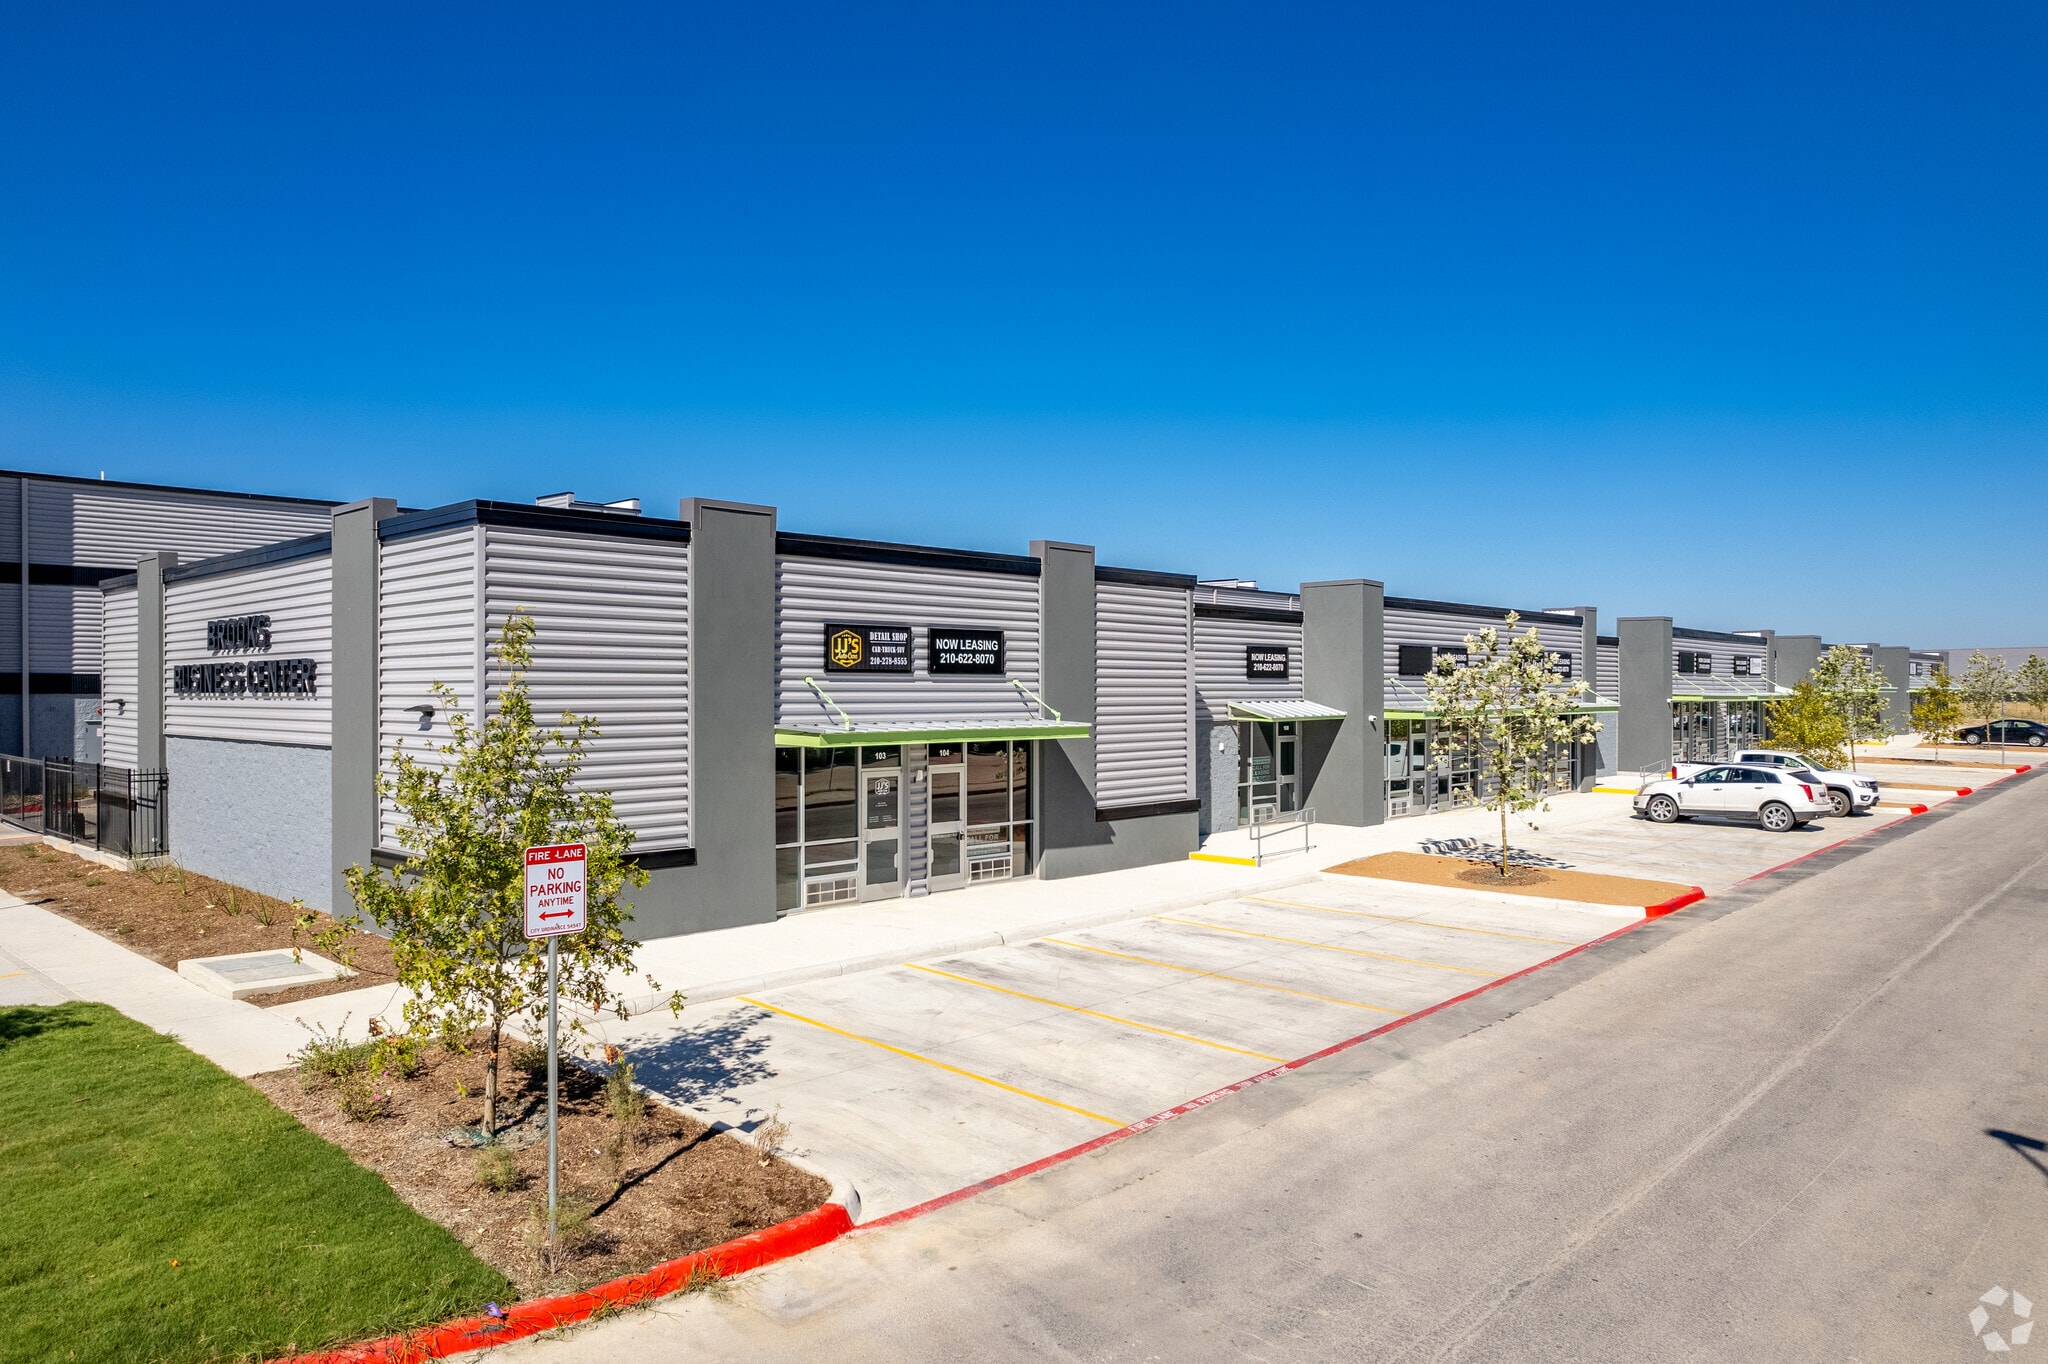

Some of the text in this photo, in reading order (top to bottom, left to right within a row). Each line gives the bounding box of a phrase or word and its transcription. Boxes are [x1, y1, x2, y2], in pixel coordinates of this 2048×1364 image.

[207, 615, 272, 651] BROOKS
[869, 631, 908, 641] DETAIL SHOP
[834, 637, 859, 654] JJ'S
[936, 638, 999, 651] NOW LEASING
[939, 652, 995, 665] 210-622-8070
[1251, 653, 1286, 661] NOW LEASING
[174, 658, 317, 693] BUSINESS CENTER
[875, 752, 887, 760] 103
[939, 749, 950, 757] 104
[528, 848, 583, 861] FIRE LANE
[547, 867, 565, 880] NO
[530, 880, 581, 897] PARKING
[538, 896, 574, 908] ANYTIME
